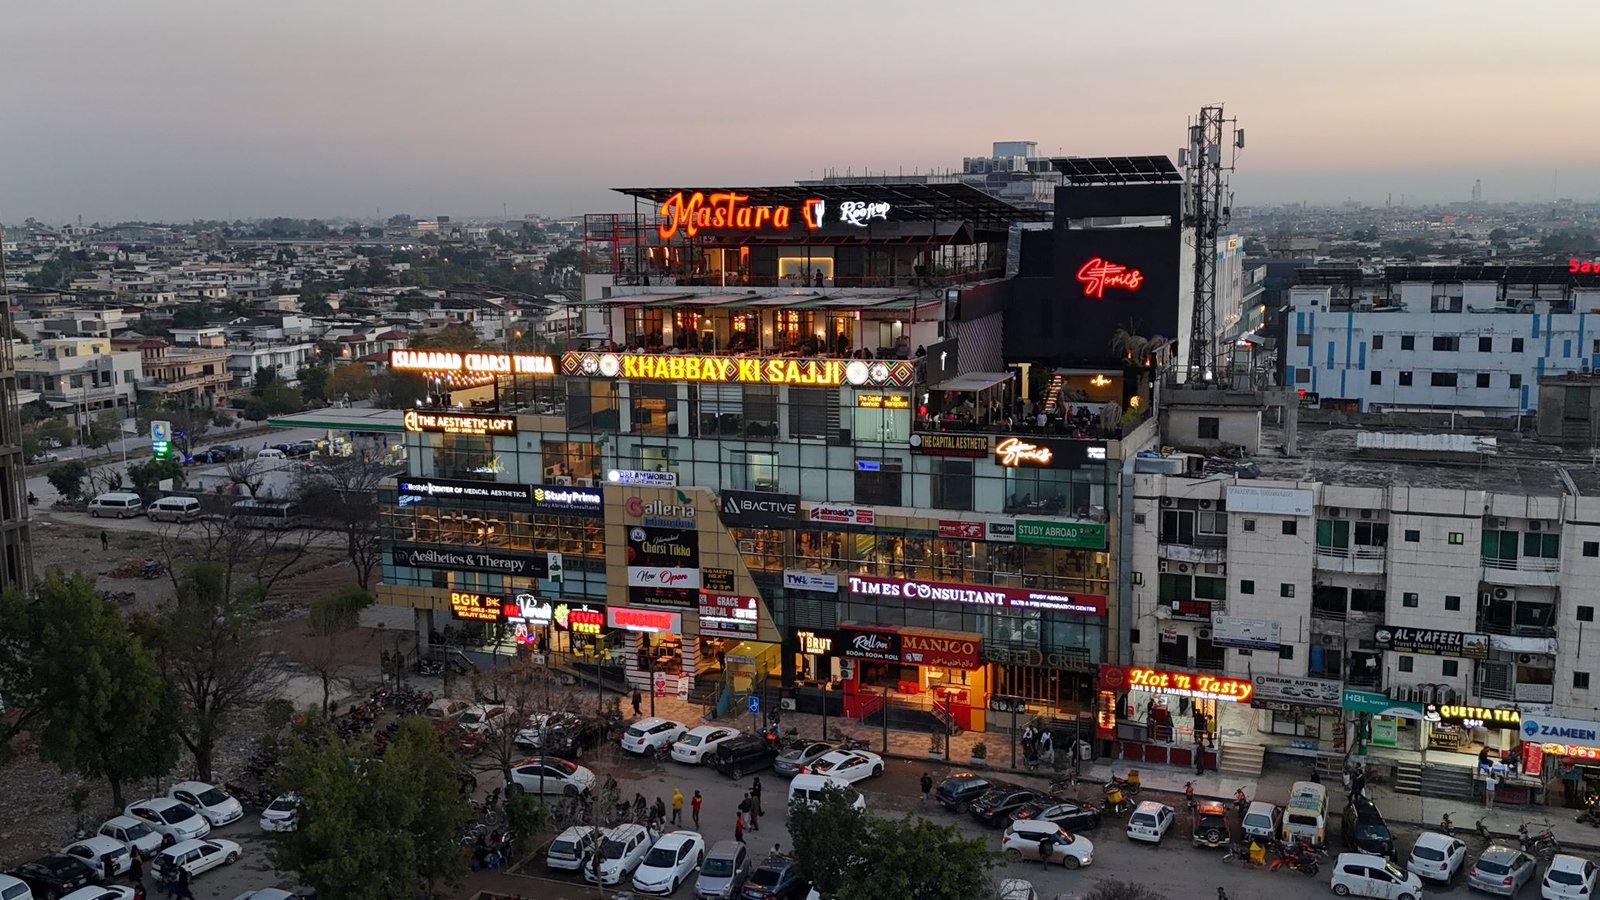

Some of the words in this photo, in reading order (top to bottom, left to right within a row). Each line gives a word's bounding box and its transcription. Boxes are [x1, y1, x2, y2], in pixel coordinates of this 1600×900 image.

[659, 192, 790, 239] Mastara
[840, 201, 890, 226] Rooftop
[1077, 258, 1143, 297] Stories
[391, 351, 462, 369] ISLAMABAD
[464, 353, 511, 371] CHARSI
[512, 355, 555, 374] TIKKA
[624, 355, 729, 380] KHABBAY
[739, 358, 761, 382] KI
[768, 360, 841, 384] SAJJI
[418, 415, 436, 427] THE
[437, 417, 488, 430] AESTHETIC
[488, 419, 514, 431] LOFT
[921, 435, 932, 447] THE
[932, 436, 955, 449] CAPITAL
[956, 437, 987, 450] AESTHETIC
[620, 471, 674, 481] DREAMWORLD
[432, 485, 453, 493] CENTER
[454, 486, 463, 494] OF
[464, 487, 489, 496] MEDICAL
[490, 489, 527, 498] AESTHETICS
[625, 496, 695, 518] Galleria
[1018, 525, 1043, 535] STUDY
[1045, 526, 1078, 538] ABROAD
[642, 541, 667, 554] Charsi
[668, 543, 691, 557] Tikka
[409, 550, 464, 566] Aesthetics
[466, 554, 475, 566] &
[477, 555, 526, 572] Therapy
[637, 569, 657, 582] Now
[660, 569, 688, 586] Open
[849, 578, 900, 596] TIMES
[903, 582, 1006, 605] CONSULTANT
[451, 592, 480, 607] BGK
[717, 596, 739, 607] GRACE
[1040, 602, 1075, 610] PREPARATION
[569, 611, 604, 625] SEVEN
[699, 605, 727, 617] MEDICAL
[572, 621, 600, 634] FRIES
[806, 637, 832, 651] BRUT
[1394, 628, 1461, 645] AL-KAFEEL
[865, 651, 883, 659] BOOM
[1130, 669, 1168, 687] Hot
[1198, 676, 1252, 700] Tasty
[1265, 677, 1292, 685] DREAM
[1294, 679, 1319, 687] AUTOS
[1163, 687, 1191, 697] PARATHA
[1345, 693, 1368, 703] HBL
[1441, 705, 1492, 720] QUETTA
[1493, 709, 1520, 722] TEA
[1541, 725, 1596, 741] ZAMEEN
